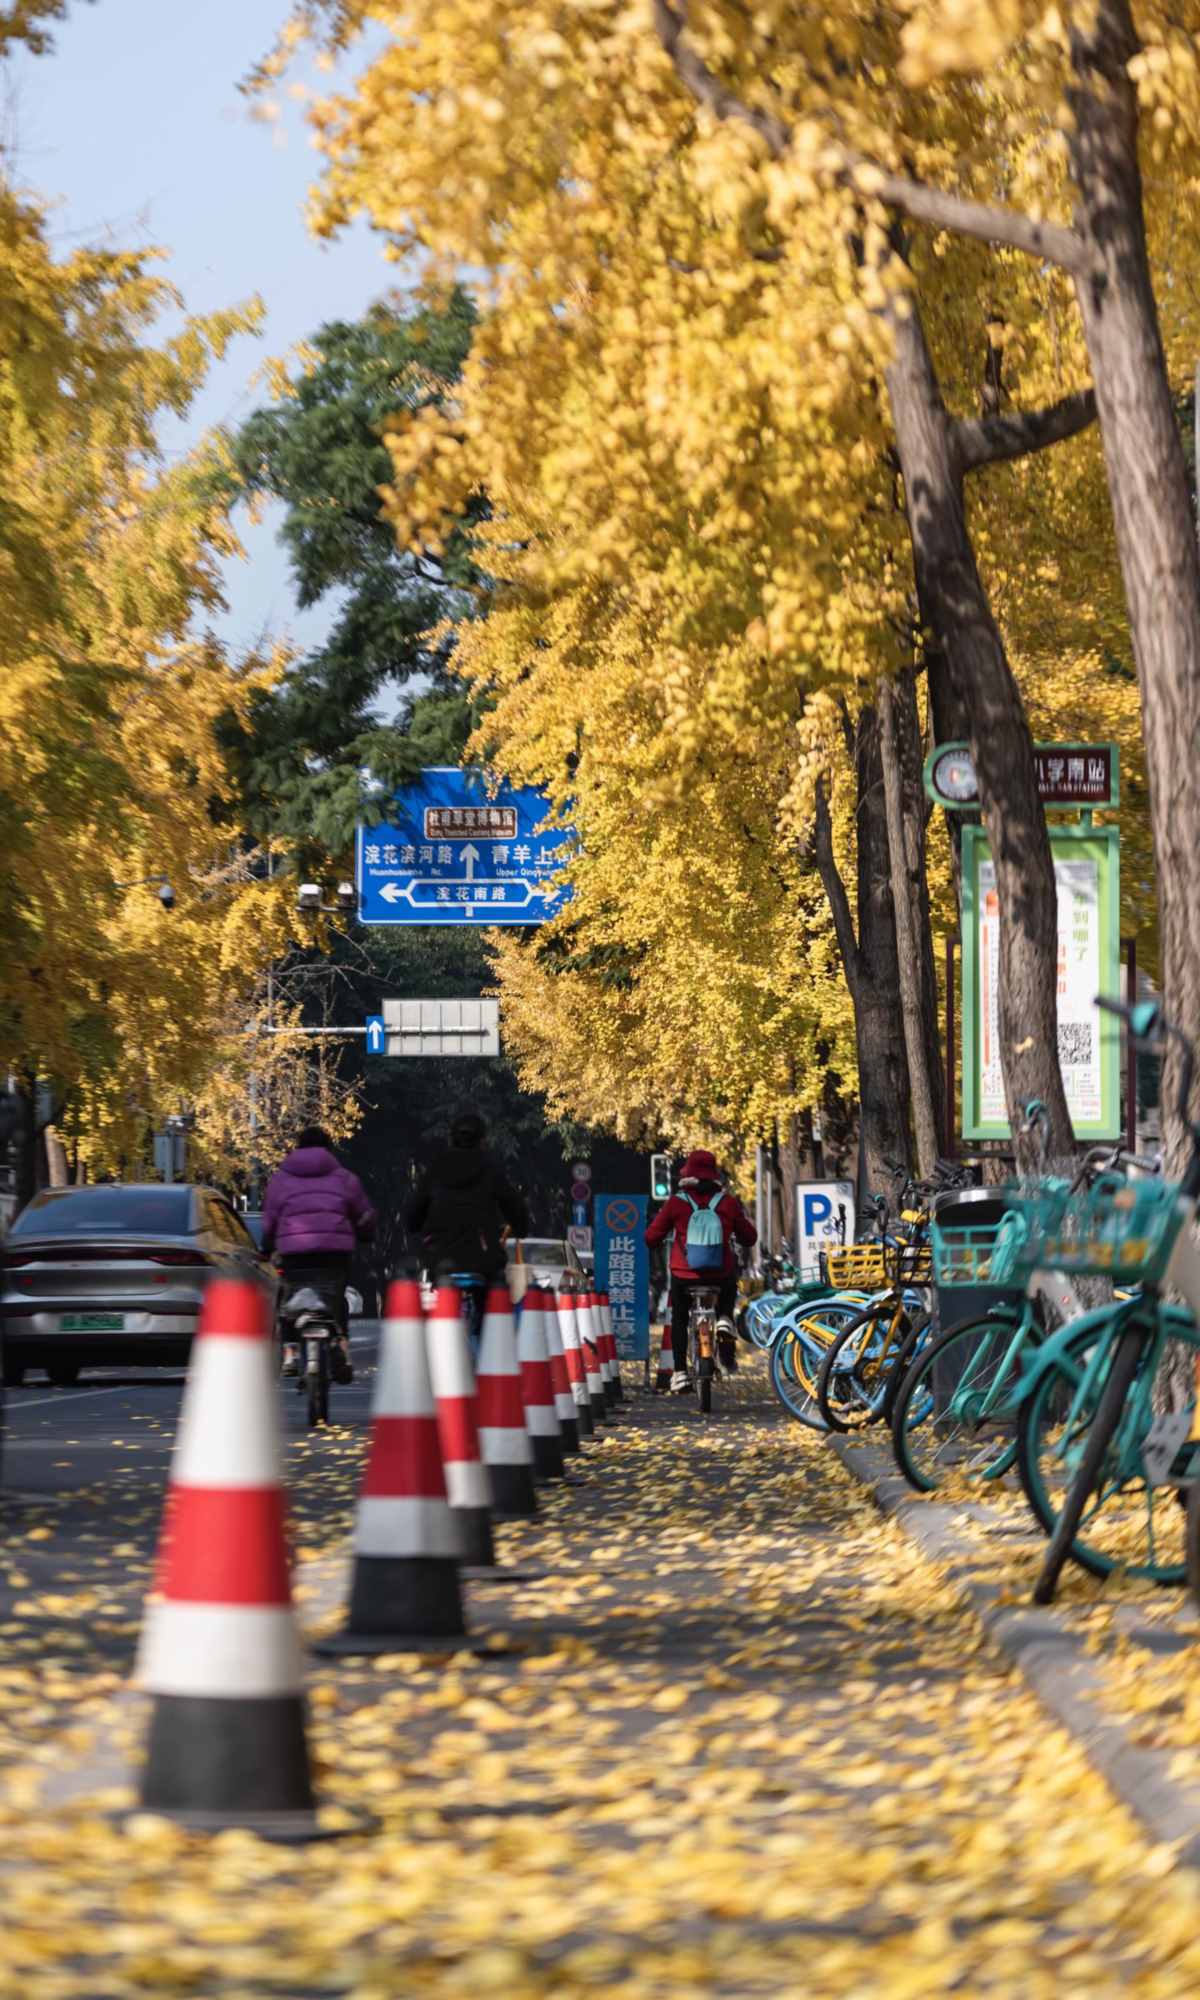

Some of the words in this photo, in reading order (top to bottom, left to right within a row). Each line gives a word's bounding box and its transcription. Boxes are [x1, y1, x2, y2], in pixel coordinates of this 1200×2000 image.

[364, 844, 453, 865] 浣花滨河路
[436, 887, 506, 901] 浣花南路
[804, 1194, 832, 1236] P
